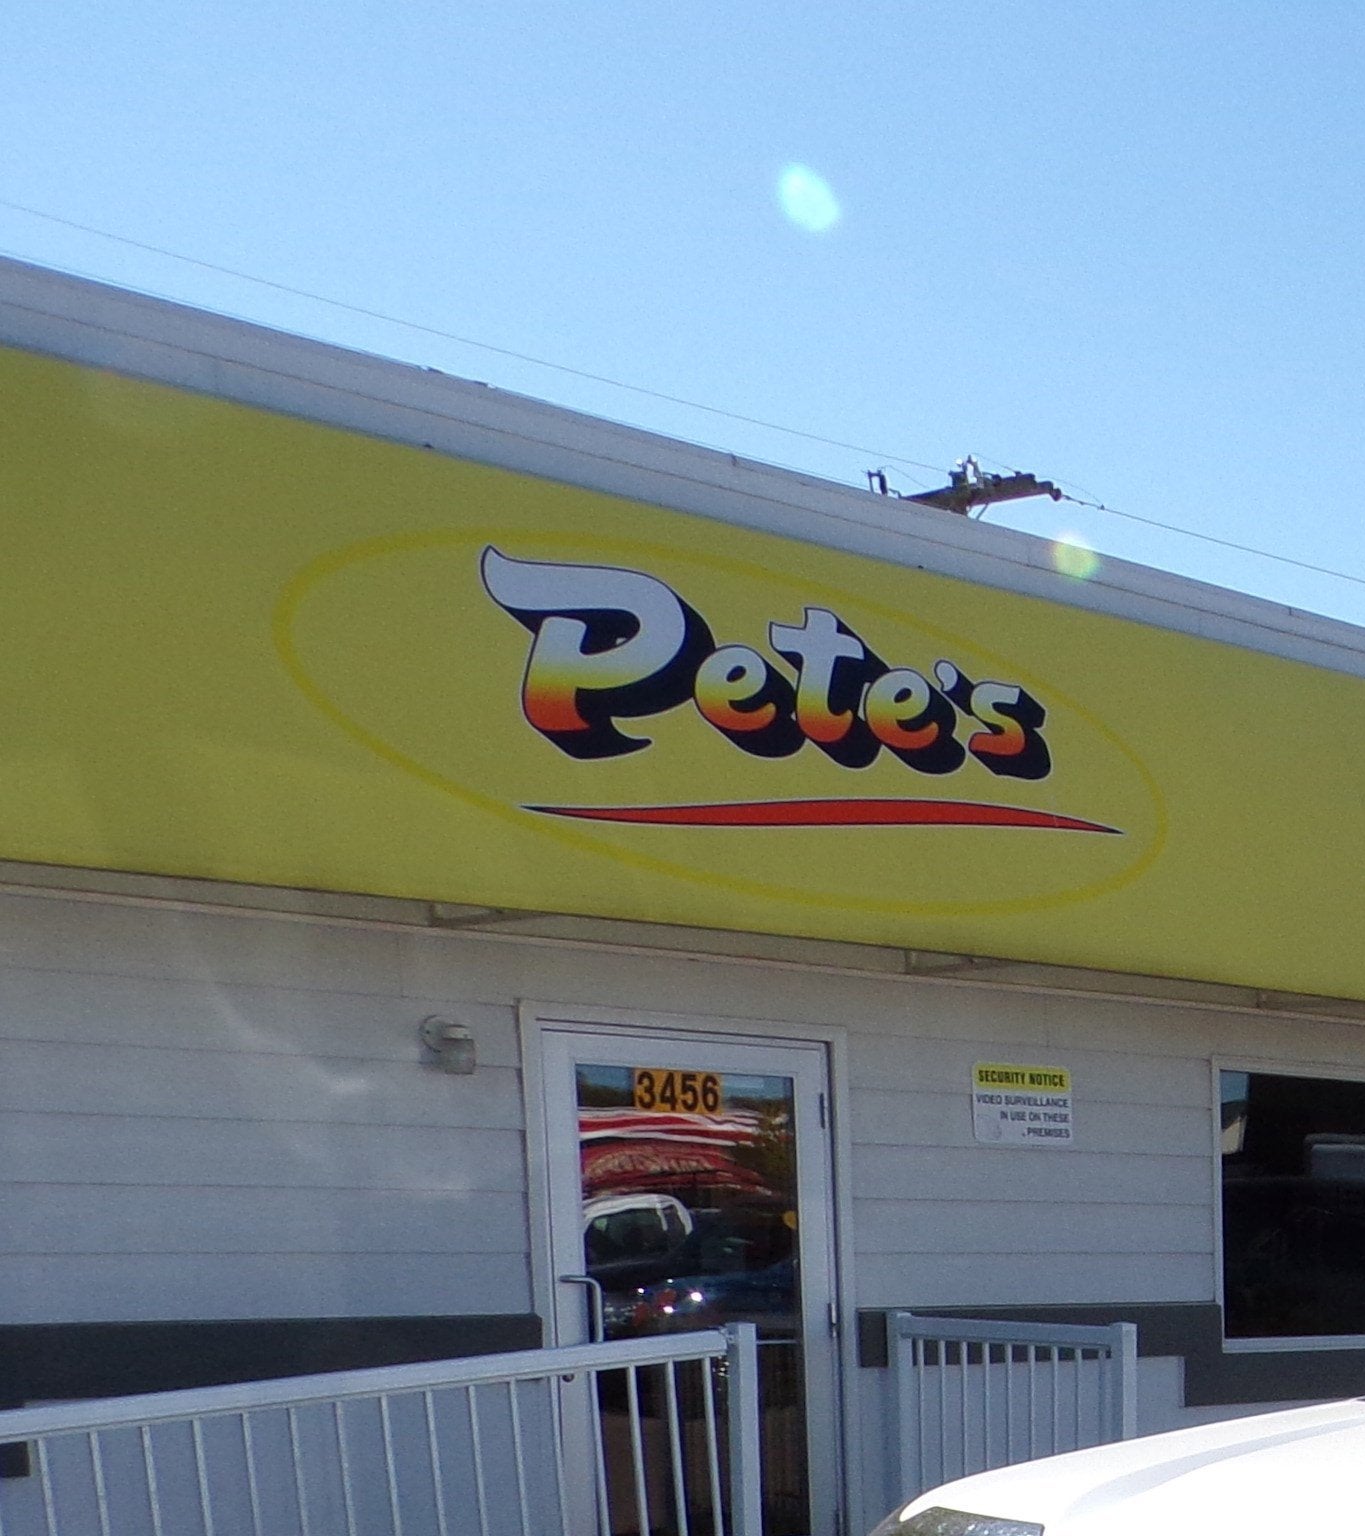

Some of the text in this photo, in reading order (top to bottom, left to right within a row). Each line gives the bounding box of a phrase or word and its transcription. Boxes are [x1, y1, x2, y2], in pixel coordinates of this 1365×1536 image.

[480, 543, 1052, 780] Pete's
[978, 1070, 1065, 1087] SECURITY NOTICE
[636, 1071, 719, 1112] 3456
[976, 1093, 1069, 1107] VIDEO SURVEILLANCE
[1000, 1111, 1070, 1123] IN USE ON THESE
[1026, 1127, 1071, 1139] PREMISES
